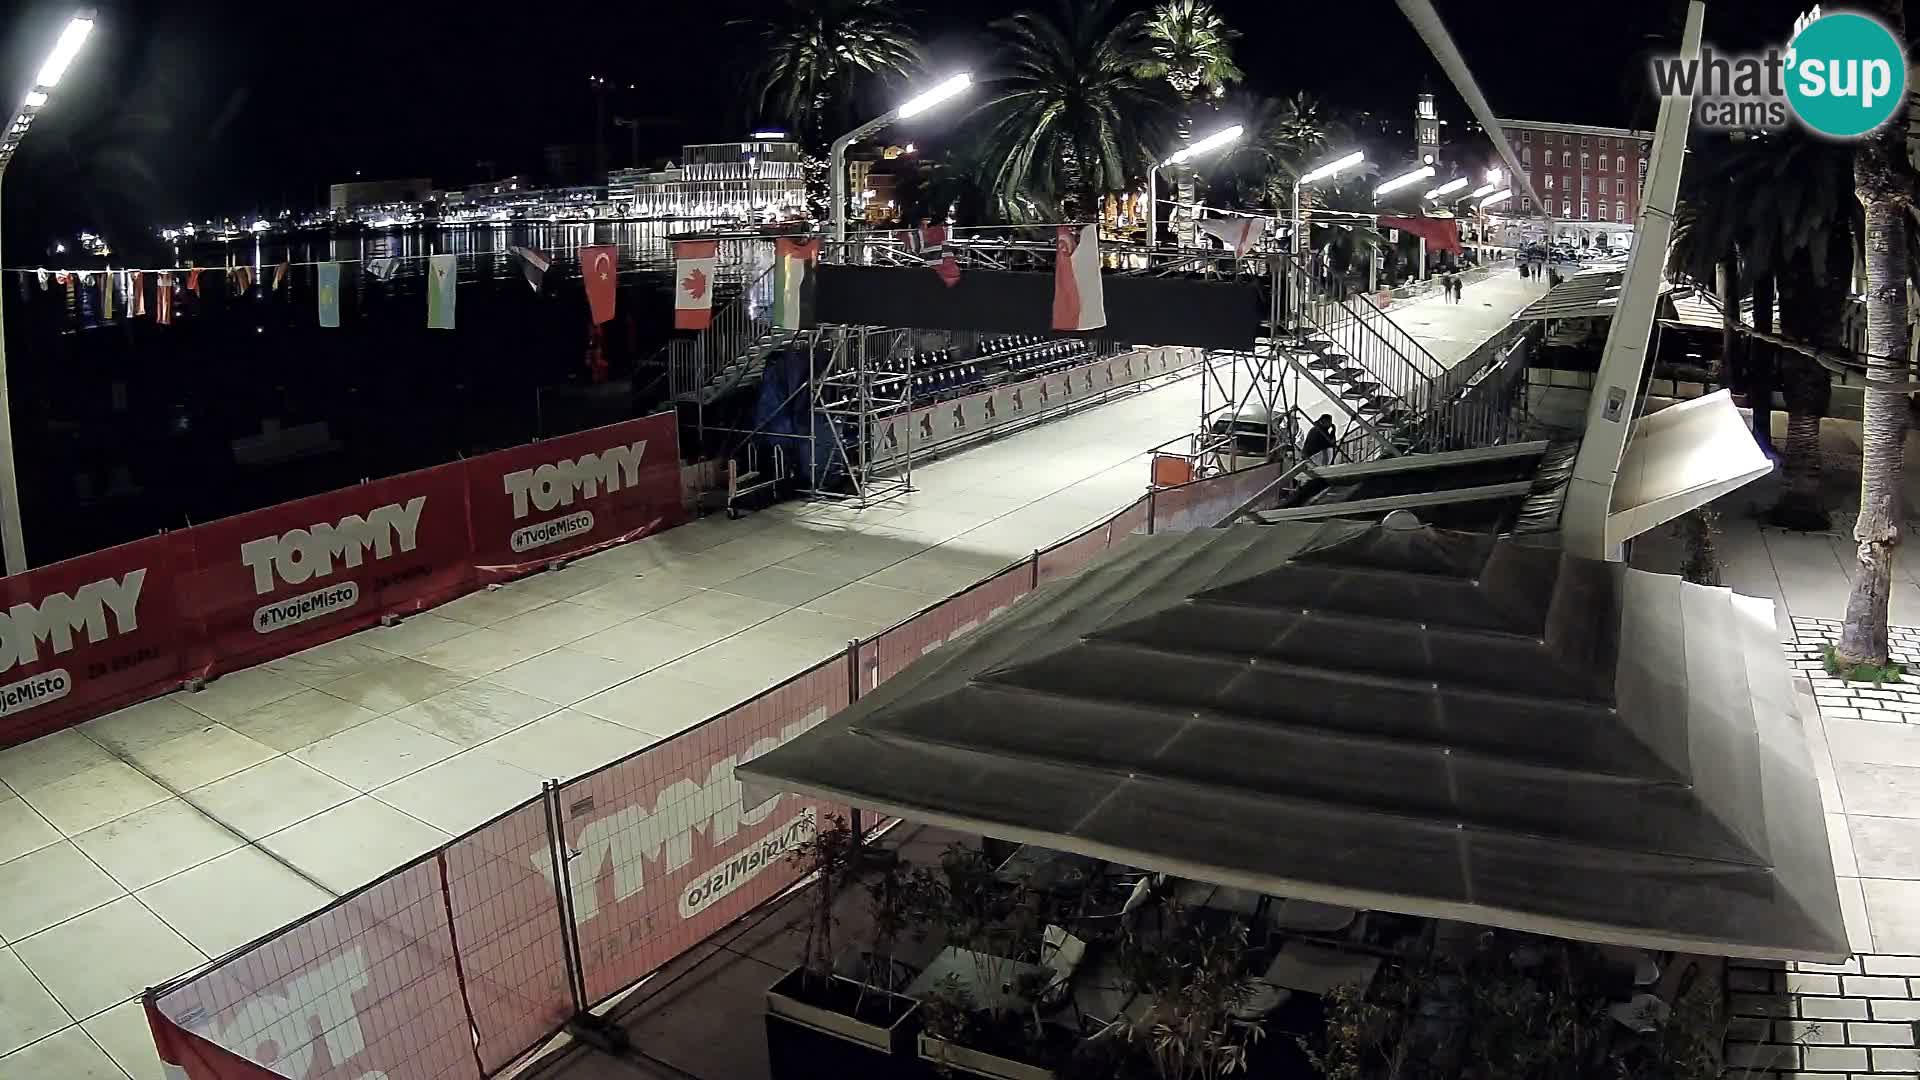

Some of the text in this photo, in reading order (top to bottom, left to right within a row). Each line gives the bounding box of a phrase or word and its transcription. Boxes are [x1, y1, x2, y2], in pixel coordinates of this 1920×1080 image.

[504, 440, 648, 518] TOMMY
[241, 496, 427, 595] TOMMY
[517, 516, 589, 547] #TvojeMisto
[260, 587, 353, 626] #TvojeMisto
[0, 677, 65, 712] jeMisto
